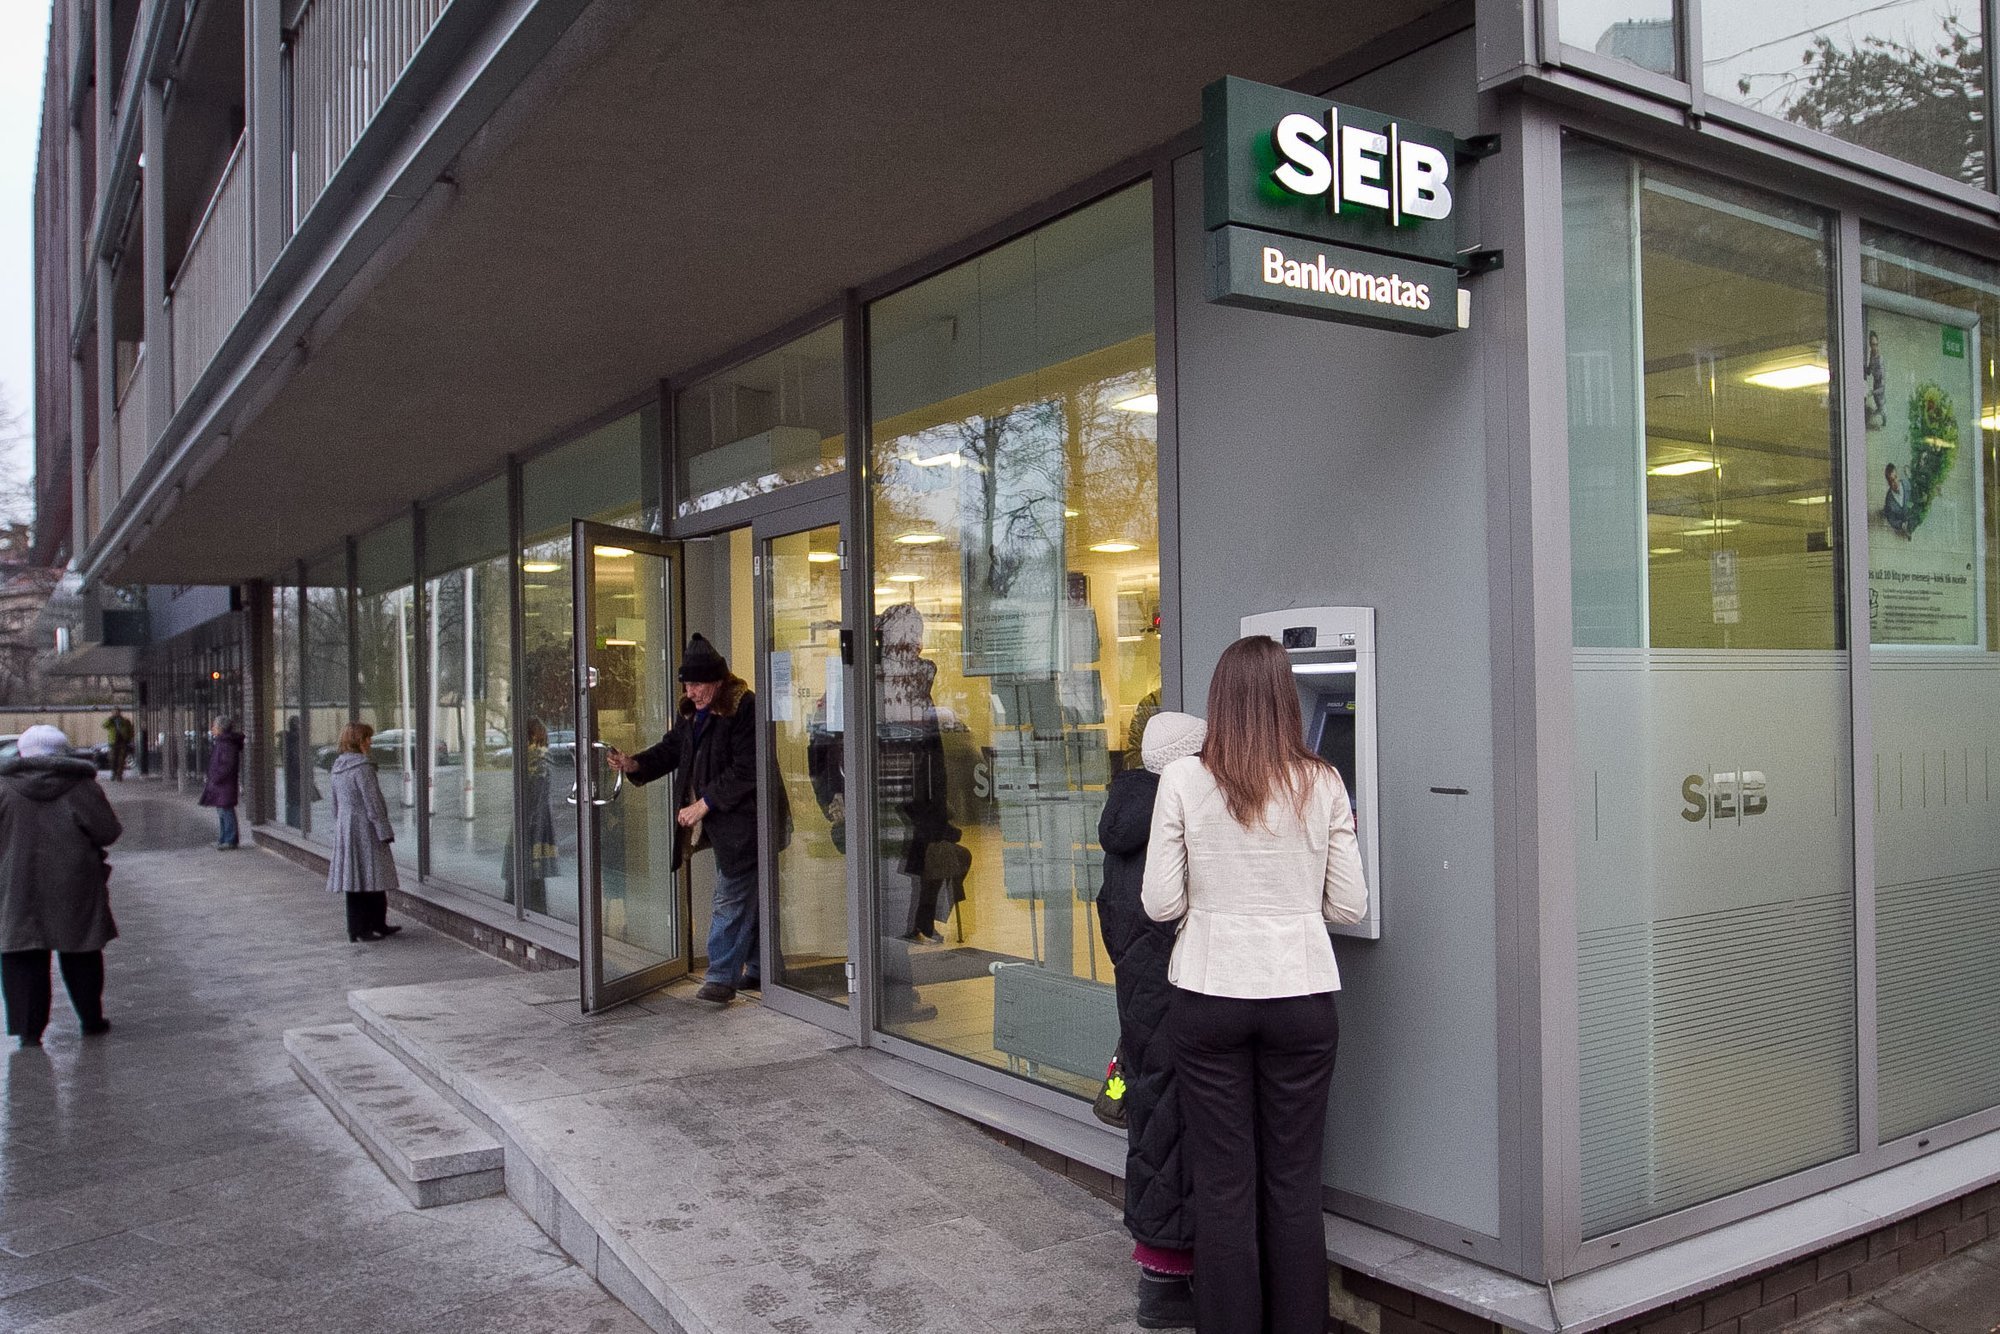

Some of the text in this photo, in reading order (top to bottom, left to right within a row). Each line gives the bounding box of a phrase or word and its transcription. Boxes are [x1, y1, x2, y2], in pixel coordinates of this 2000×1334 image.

[1272, 107, 1453, 226] SEB
[1263, 247, 1430, 311] Bankomatas
[1681, 770, 1768, 822] SEB
